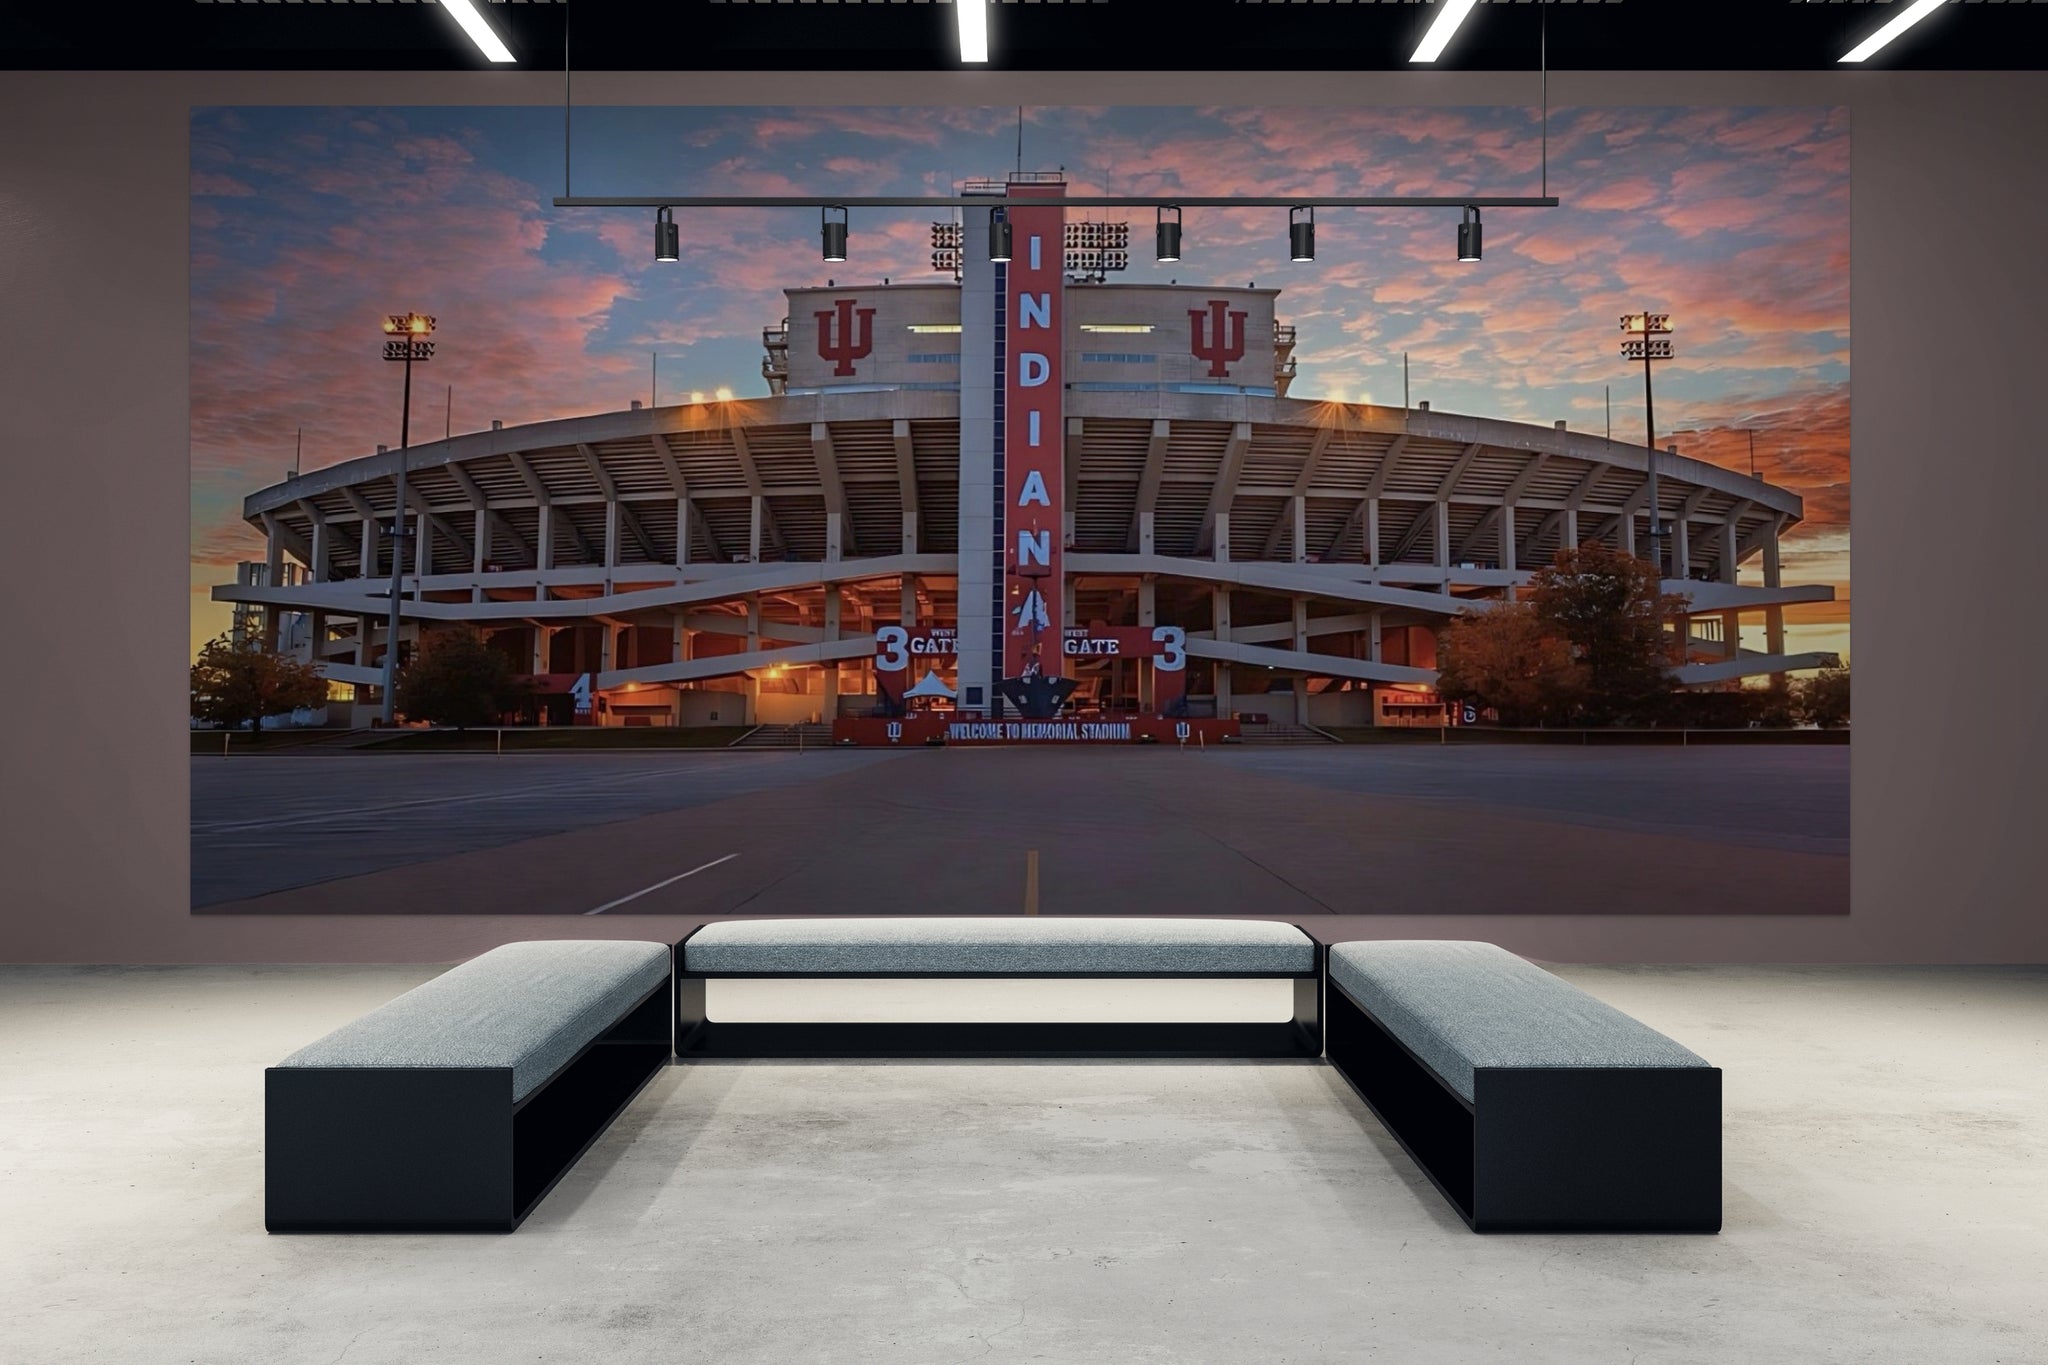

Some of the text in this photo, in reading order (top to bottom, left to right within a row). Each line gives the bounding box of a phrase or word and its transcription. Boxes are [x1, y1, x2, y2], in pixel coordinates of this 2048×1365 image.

[1018, 235, 1051, 629] INDIANA
[876, 626, 909, 672] 3
[1064, 639, 1120, 655] GATE
[1151, 626, 1186, 672] 3
[568, 672, 593, 708] 4
[950, 723, 1131, 740] WELCOME TO MEMORIAL STADIUM
